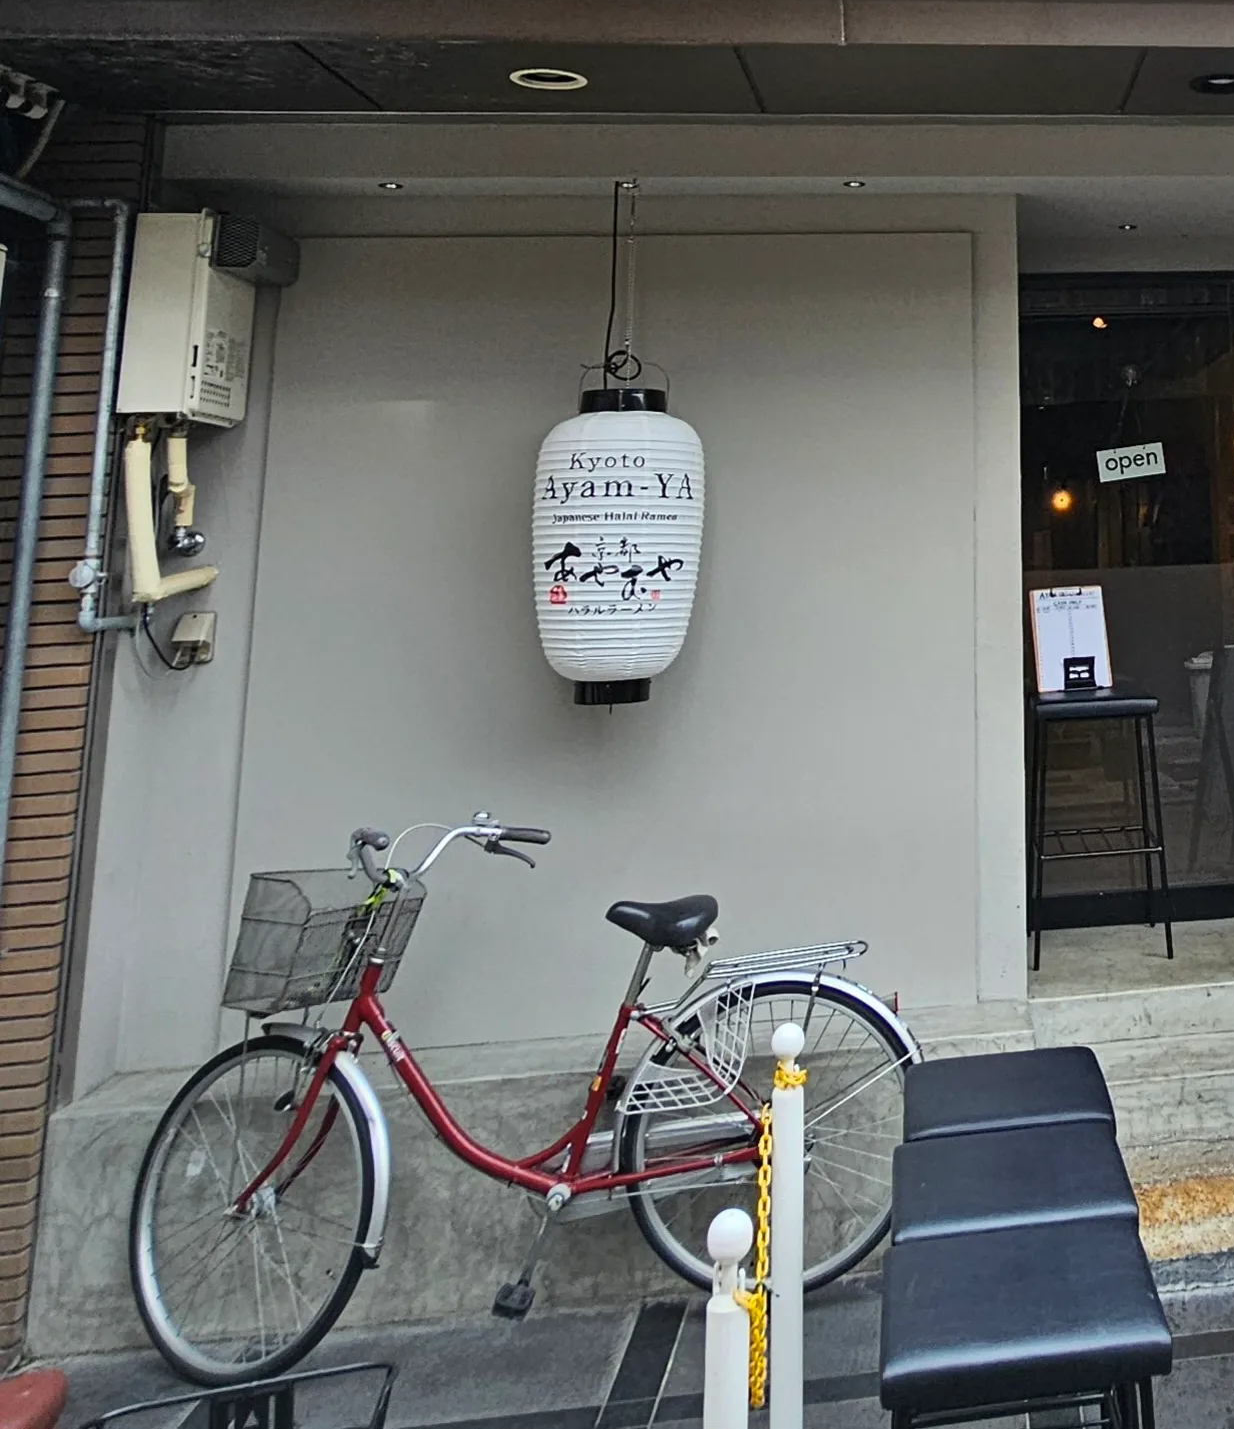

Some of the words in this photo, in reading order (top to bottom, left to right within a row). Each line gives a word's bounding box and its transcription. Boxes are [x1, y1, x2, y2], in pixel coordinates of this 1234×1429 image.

[568, 452, 646, 473] Kyoto
[1105, 452, 1158, 475] open
[541, 473, 694, 505] Ayam-YA
[552, 512, 600, 525] Japanese
[591, 535, 642, 563] 京都
[567, 602, 658, 616] ハラルラーメン
